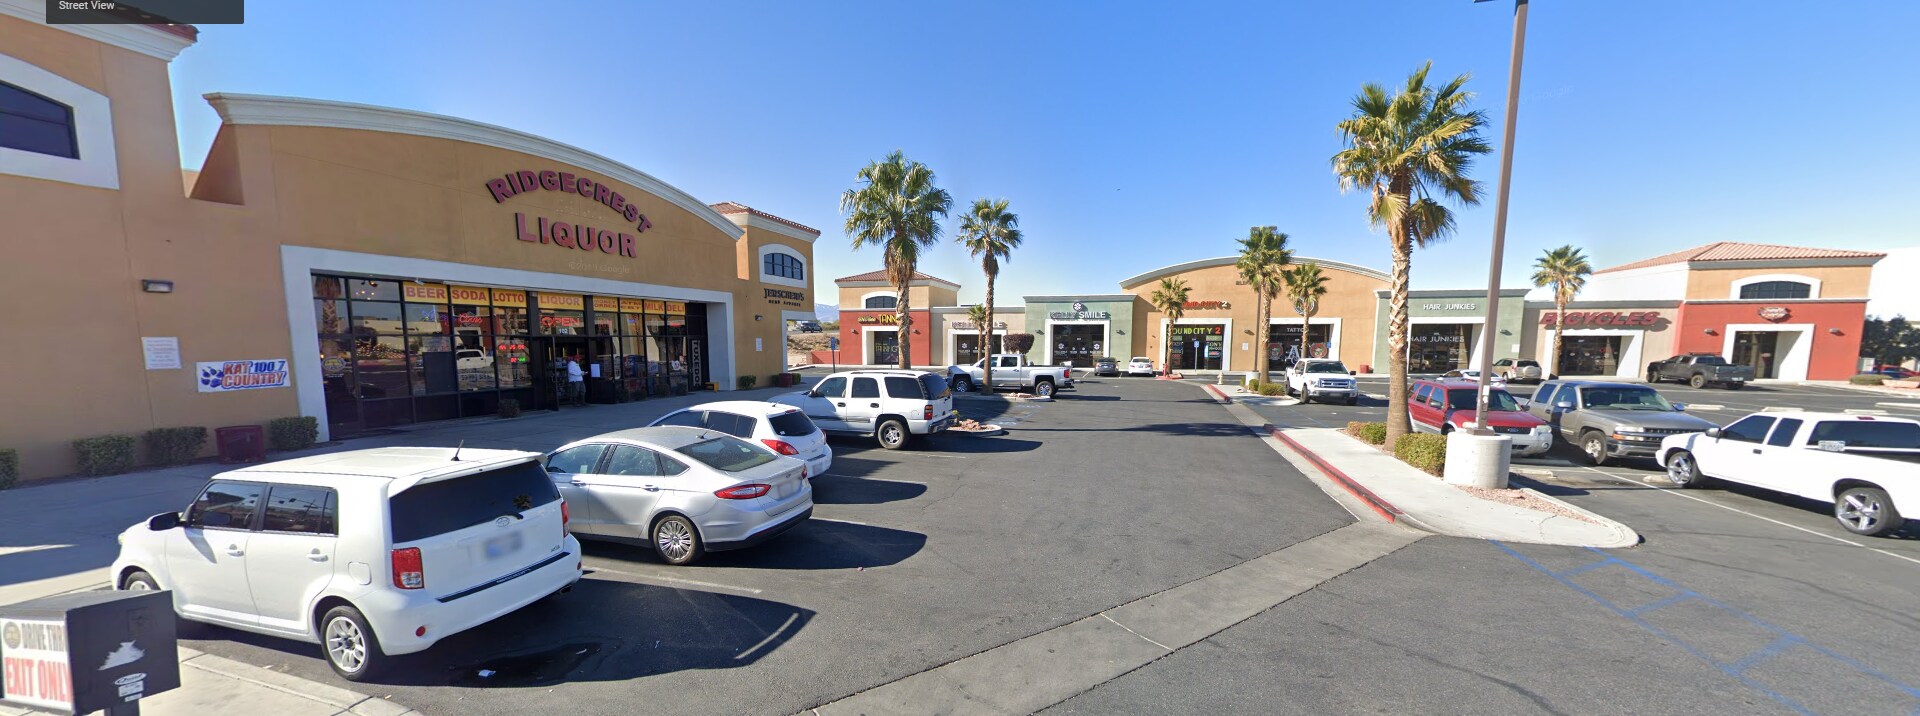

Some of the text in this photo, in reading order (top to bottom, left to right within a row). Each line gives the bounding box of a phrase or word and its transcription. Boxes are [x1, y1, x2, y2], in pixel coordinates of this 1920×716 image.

[485, 170, 653, 234] RIDGECREST
[515, 212, 638, 259] LIQUOR
[405, 285, 446, 299] BEER
[452, 288, 487, 301] SODA
[493, 291, 525, 303] LOTTO
[540, 295, 580, 306] LIQUOR
[645, 302, 664, 311] MILK
[1221, 300, 1227, 308] 2
[667, 303, 685, 312] DELI
[541, 315, 580, 327] OPEN
[1079, 311, 1106, 319] SMILE
[1539, 311, 1661, 326] BCYCLES
[1215, 326, 1222, 334] 2
[1430, 335, 1465, 343] JUNKIES
[224, 363, 249, 375] KAT
[223, 373, 284, 387] COUNTRY
[21, 623, 47, 650] DRIVE
[5, 656, 73, 703] EXIT ONLY
